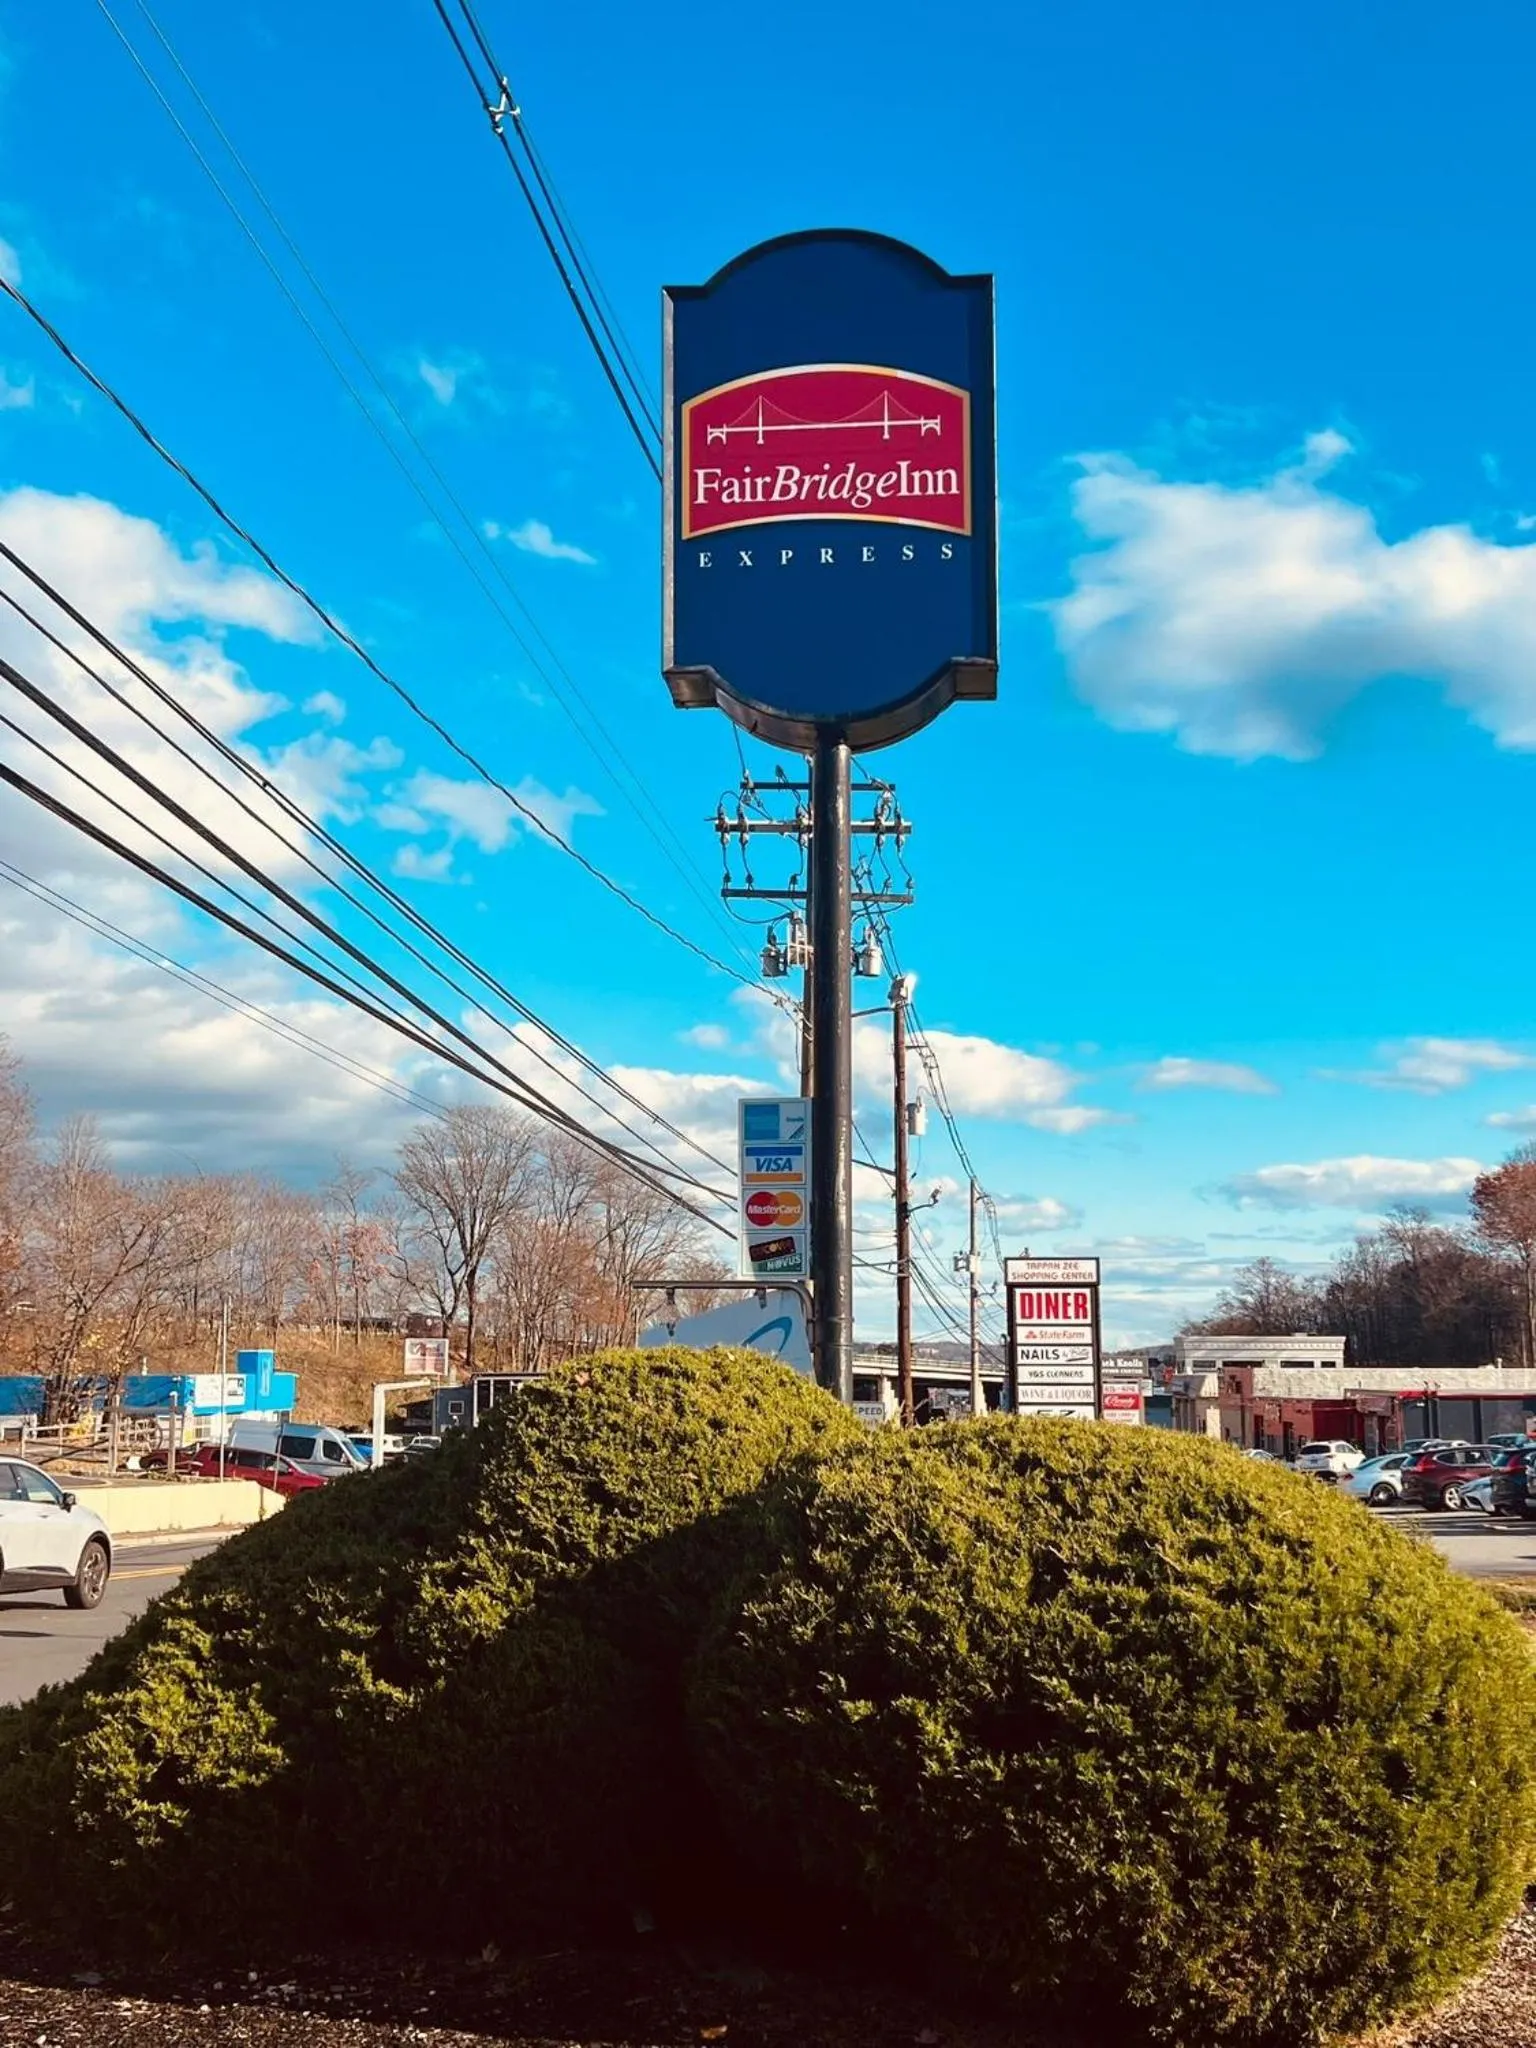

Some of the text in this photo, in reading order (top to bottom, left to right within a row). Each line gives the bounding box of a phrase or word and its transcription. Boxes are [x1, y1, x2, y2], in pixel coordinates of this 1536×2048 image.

[699, 543, 953, 568] EXPRESS
[755, 1157, 793, 1172] VISA
[747, 1204, 801, 1215] MasterCard
[766, 1254, 801, 1271] NOVUS
[1026, 1262, 1079, 1270] TAPPAN ZEE
[1011, 1272, 1094, 1280] SHOPPING CENTER
[1019, 1292, 1089, 1320] DINER
[1020, 1348, 1060, 1361] NAILS
[1046, 1370, 1084, 1378] CLEANERS
[1021, 1388, 1046, 1399] WINE
[1054, 1388, 1092, 1400] LIQUOR
